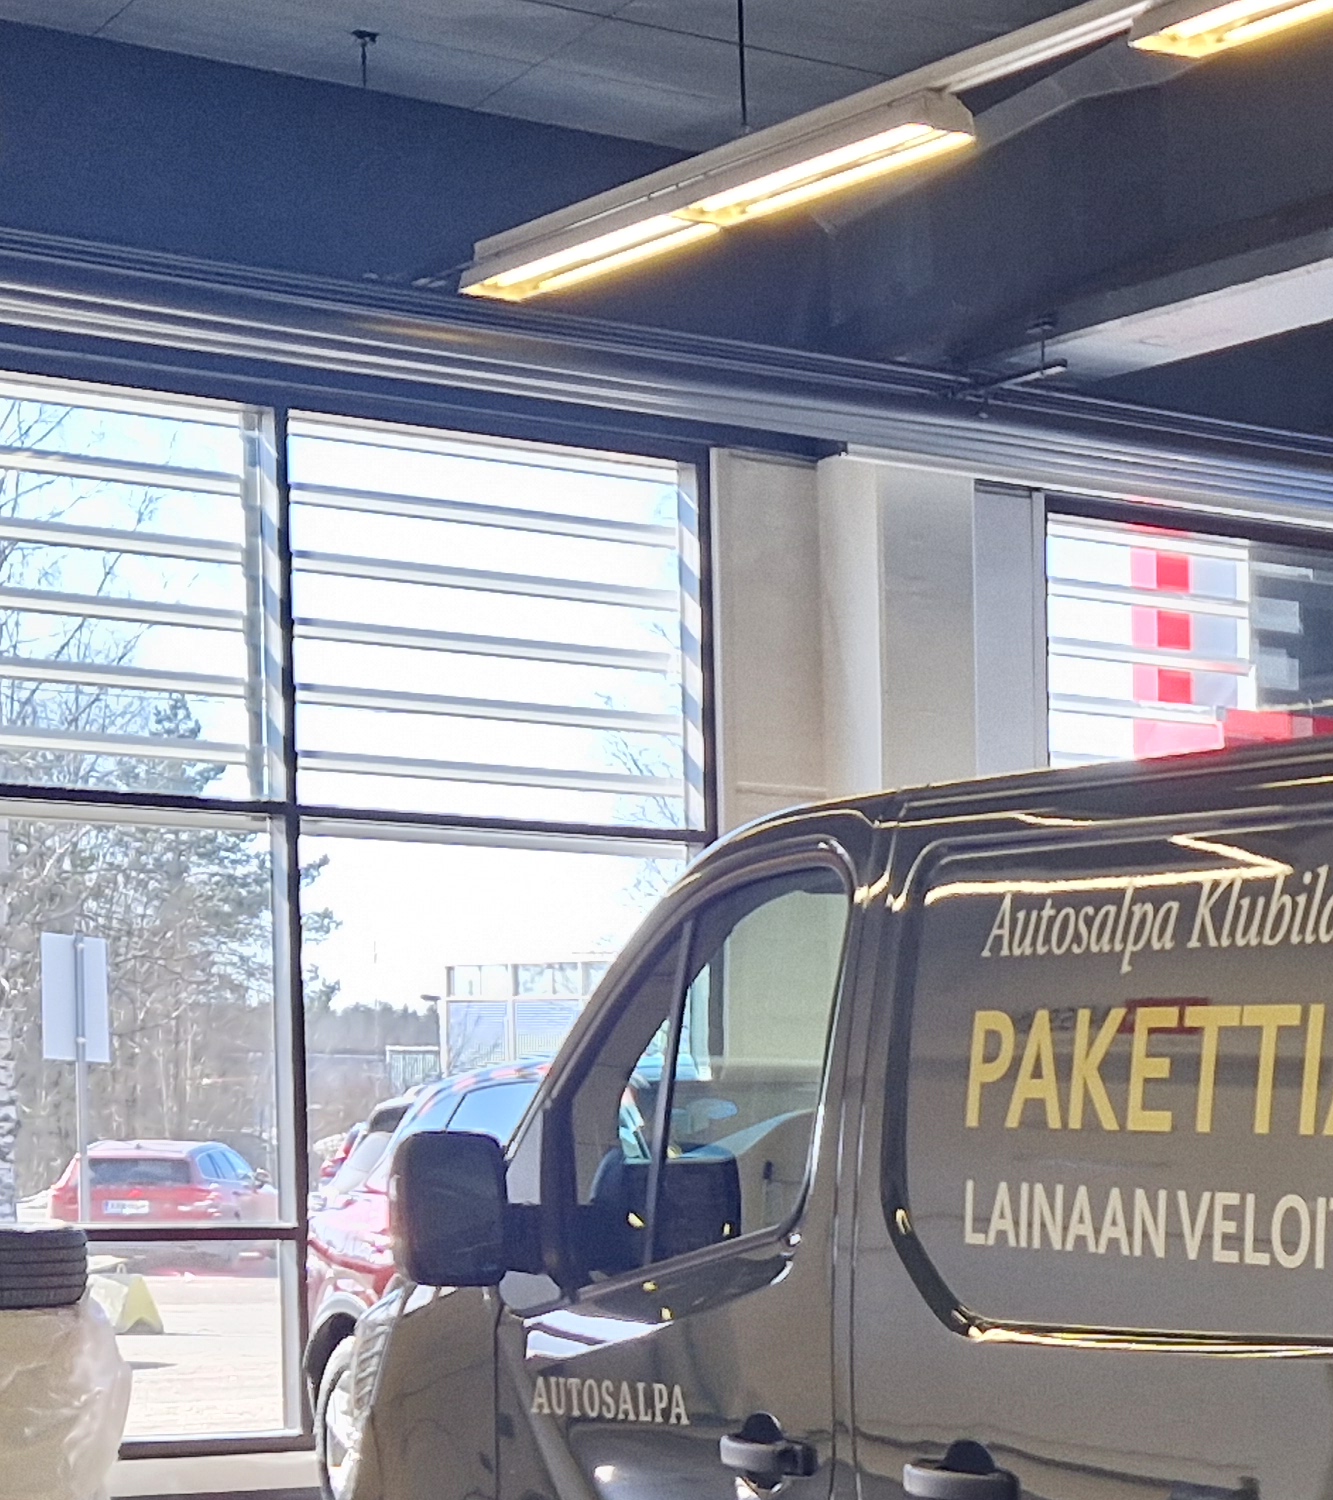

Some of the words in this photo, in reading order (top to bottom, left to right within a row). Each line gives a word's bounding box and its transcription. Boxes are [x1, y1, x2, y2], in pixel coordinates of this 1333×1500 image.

[982, 880, 1179, 972] Autosalpa
[964, 1180, 1166, 1257] LAINAAN
[531, 1375, 690, 1425] AUTOSALPA
